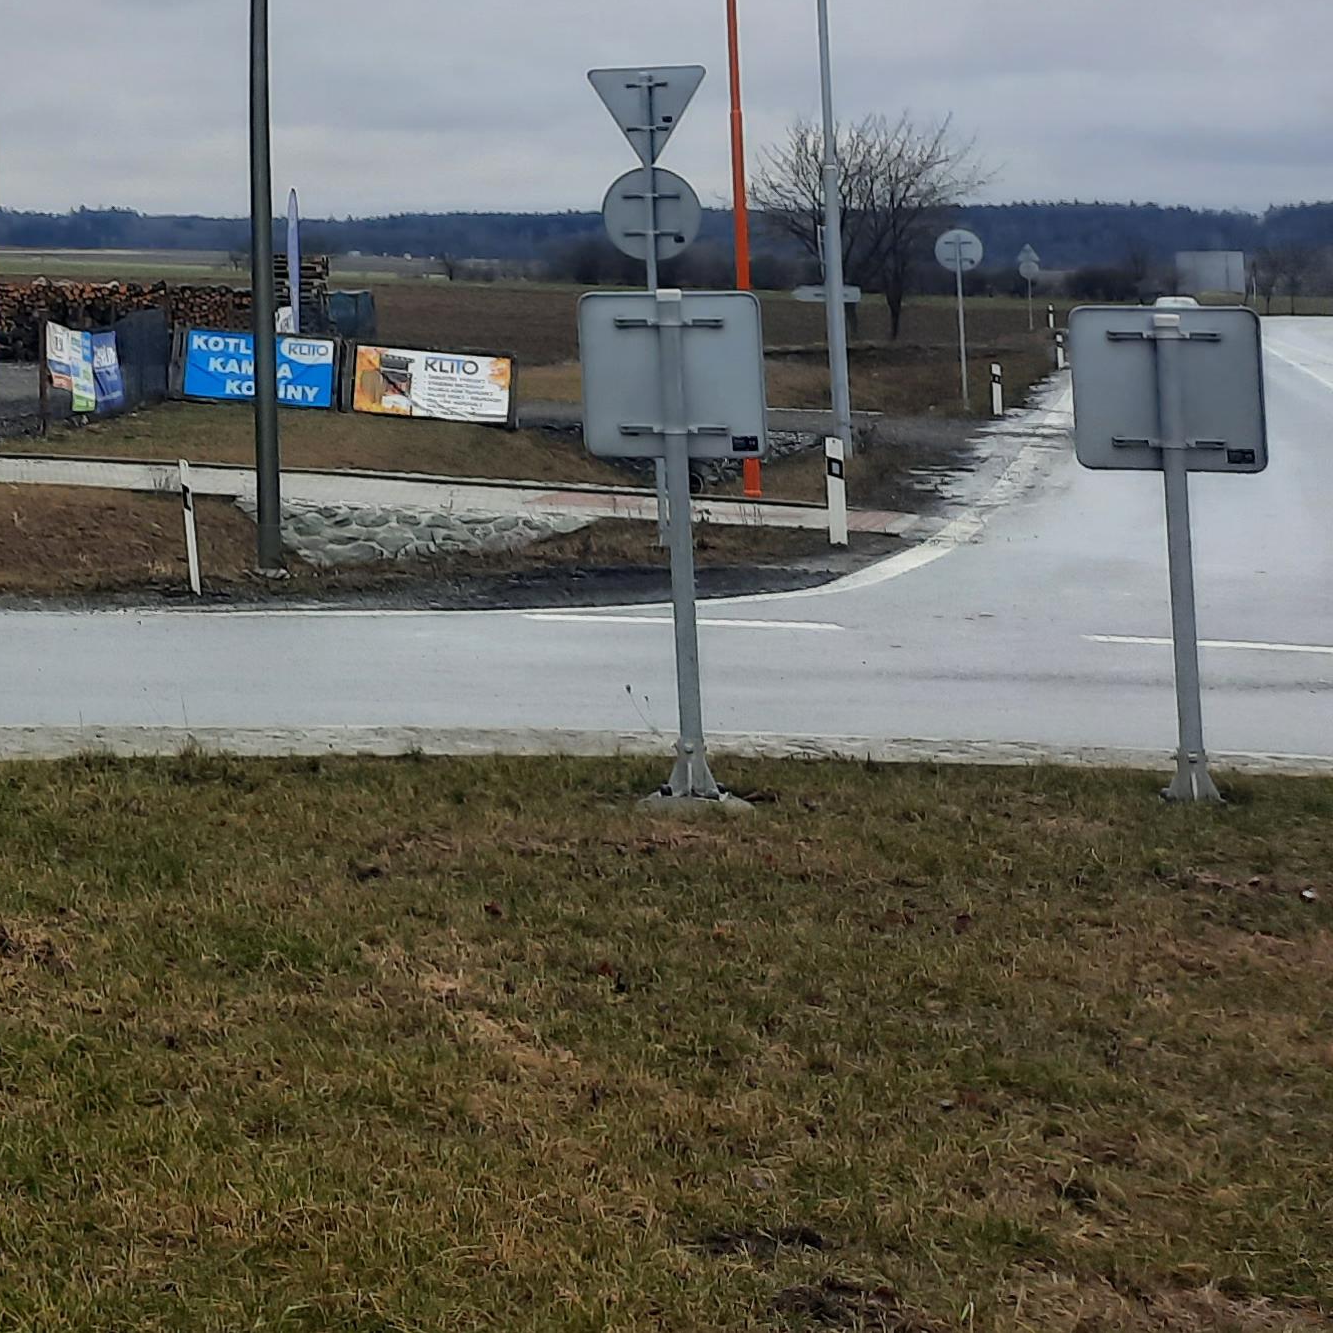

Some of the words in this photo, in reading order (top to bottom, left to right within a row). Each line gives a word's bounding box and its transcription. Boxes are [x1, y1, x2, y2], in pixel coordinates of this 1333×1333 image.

[192, 334, 252, 355] KOTL
[208, 357, 294, 380] KAA
[424, 356, 479, 375] KLITO
[224, 379, 320, 403] KOÍNY
